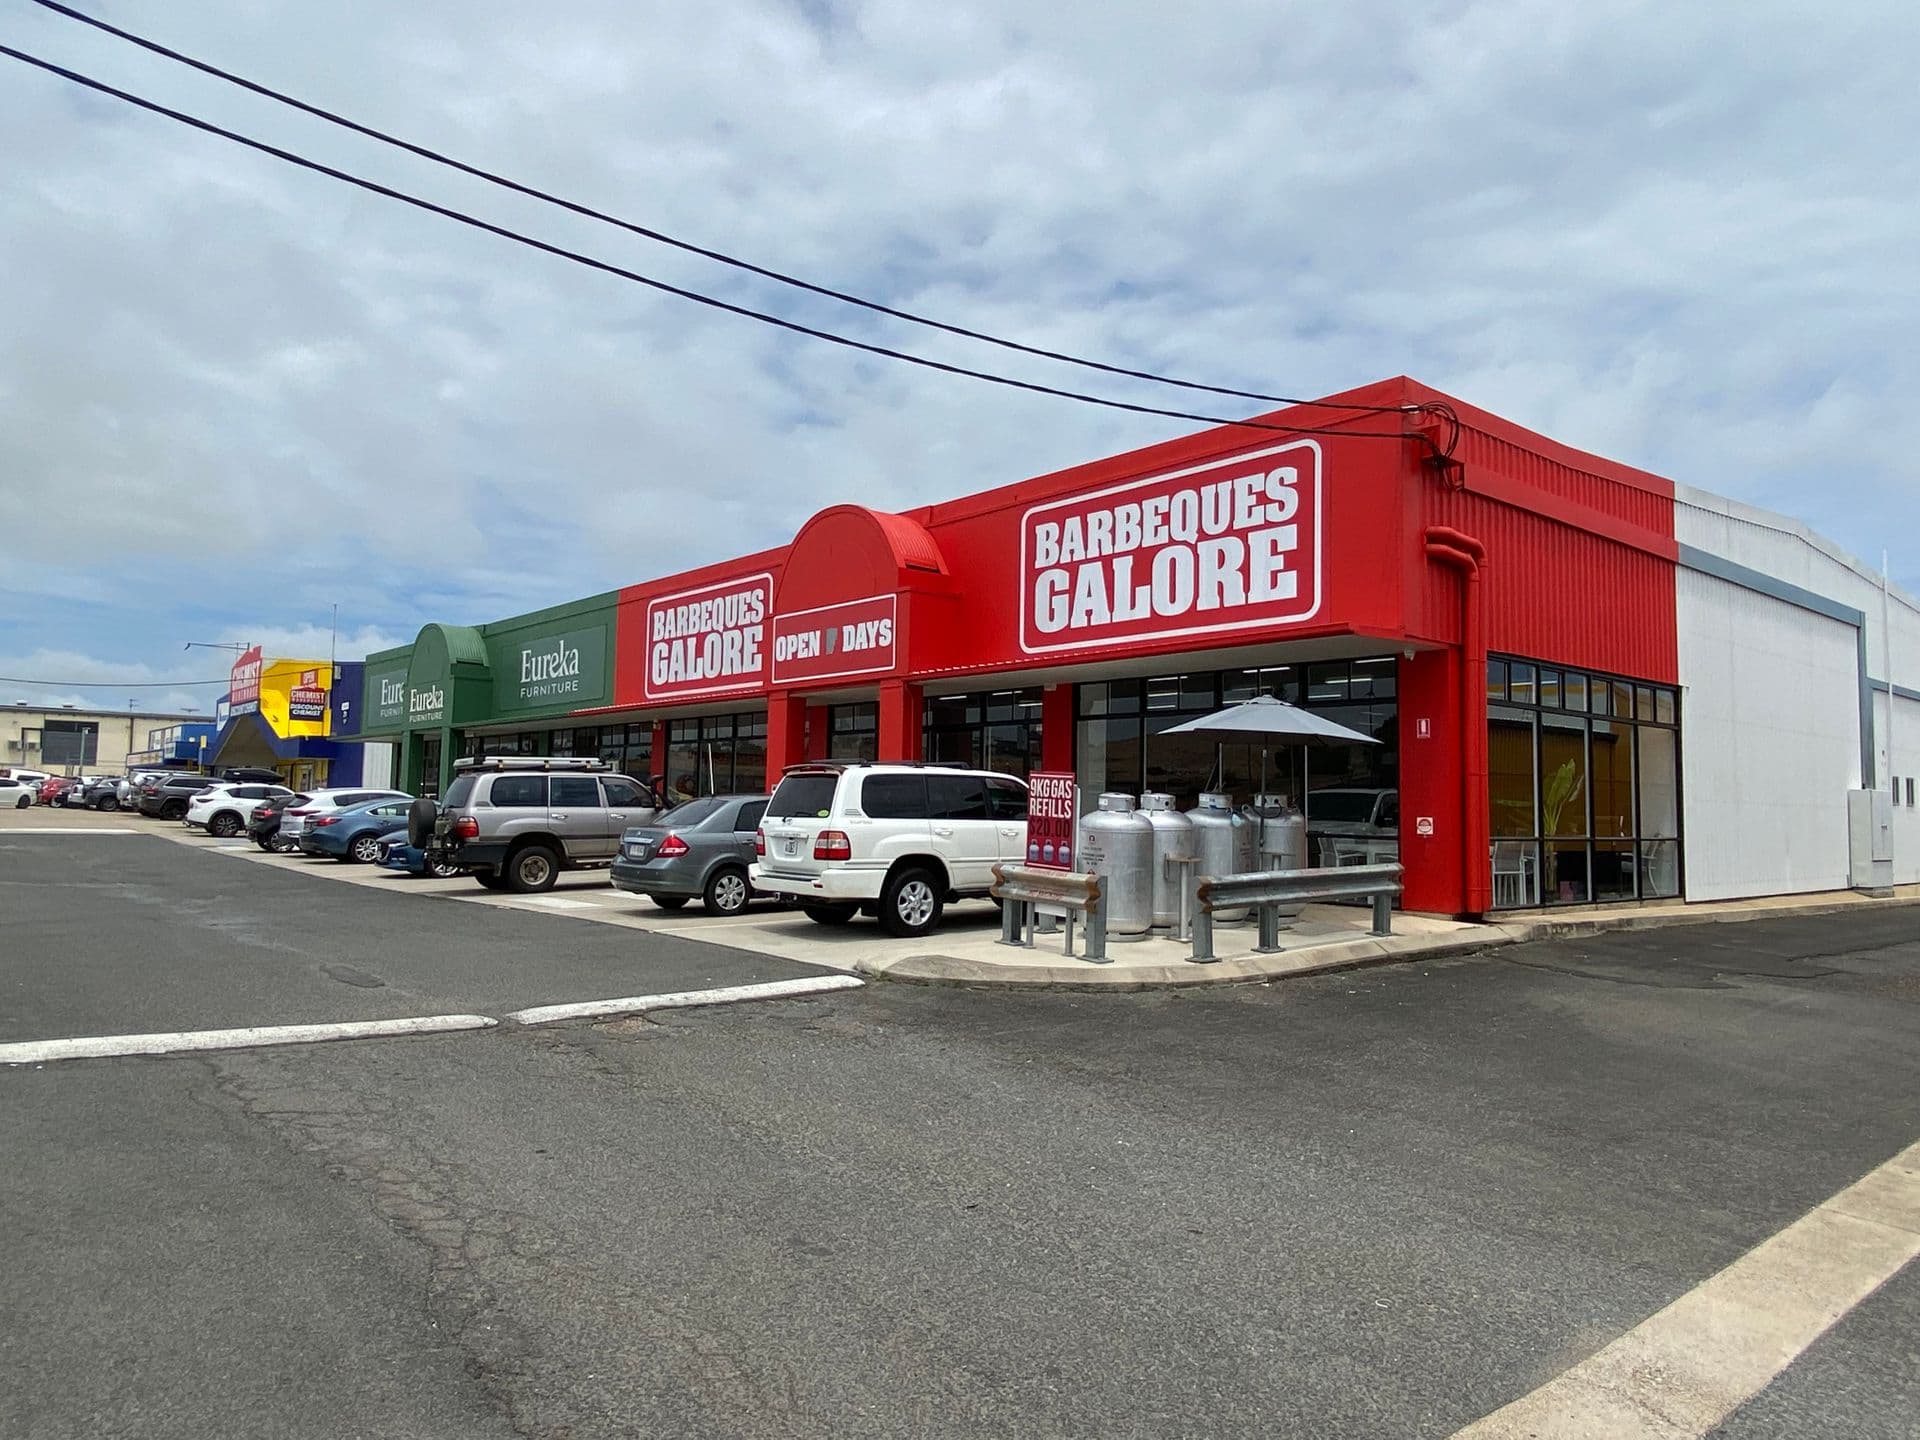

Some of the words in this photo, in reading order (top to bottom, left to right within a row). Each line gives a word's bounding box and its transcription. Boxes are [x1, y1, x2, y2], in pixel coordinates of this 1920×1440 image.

[1034, 466, 1299, 569] BARBEQUES
[1034, 524, 1298, 634] GALORE
[652, 588, 764, 642] BARBEQUES
[652, 624, 764, 686] GALORE
[775, 630, 821, 662] OPEN
[842, 618, 893, 652] DAYS
[520, 639, 580, 683] Eureka
[291, 690, 325, 701] CHEMIST
[409, 684, 444, 713] Eureka
[520, 680, 579, 698] FURNITURE
[409, 711, 443, 723] FURNITURE
[1030, 778, 1050, 798] 9KG
[1051, 779, 1073, 799] GAS
[1029, 797, 1072, 819] REFILLS
